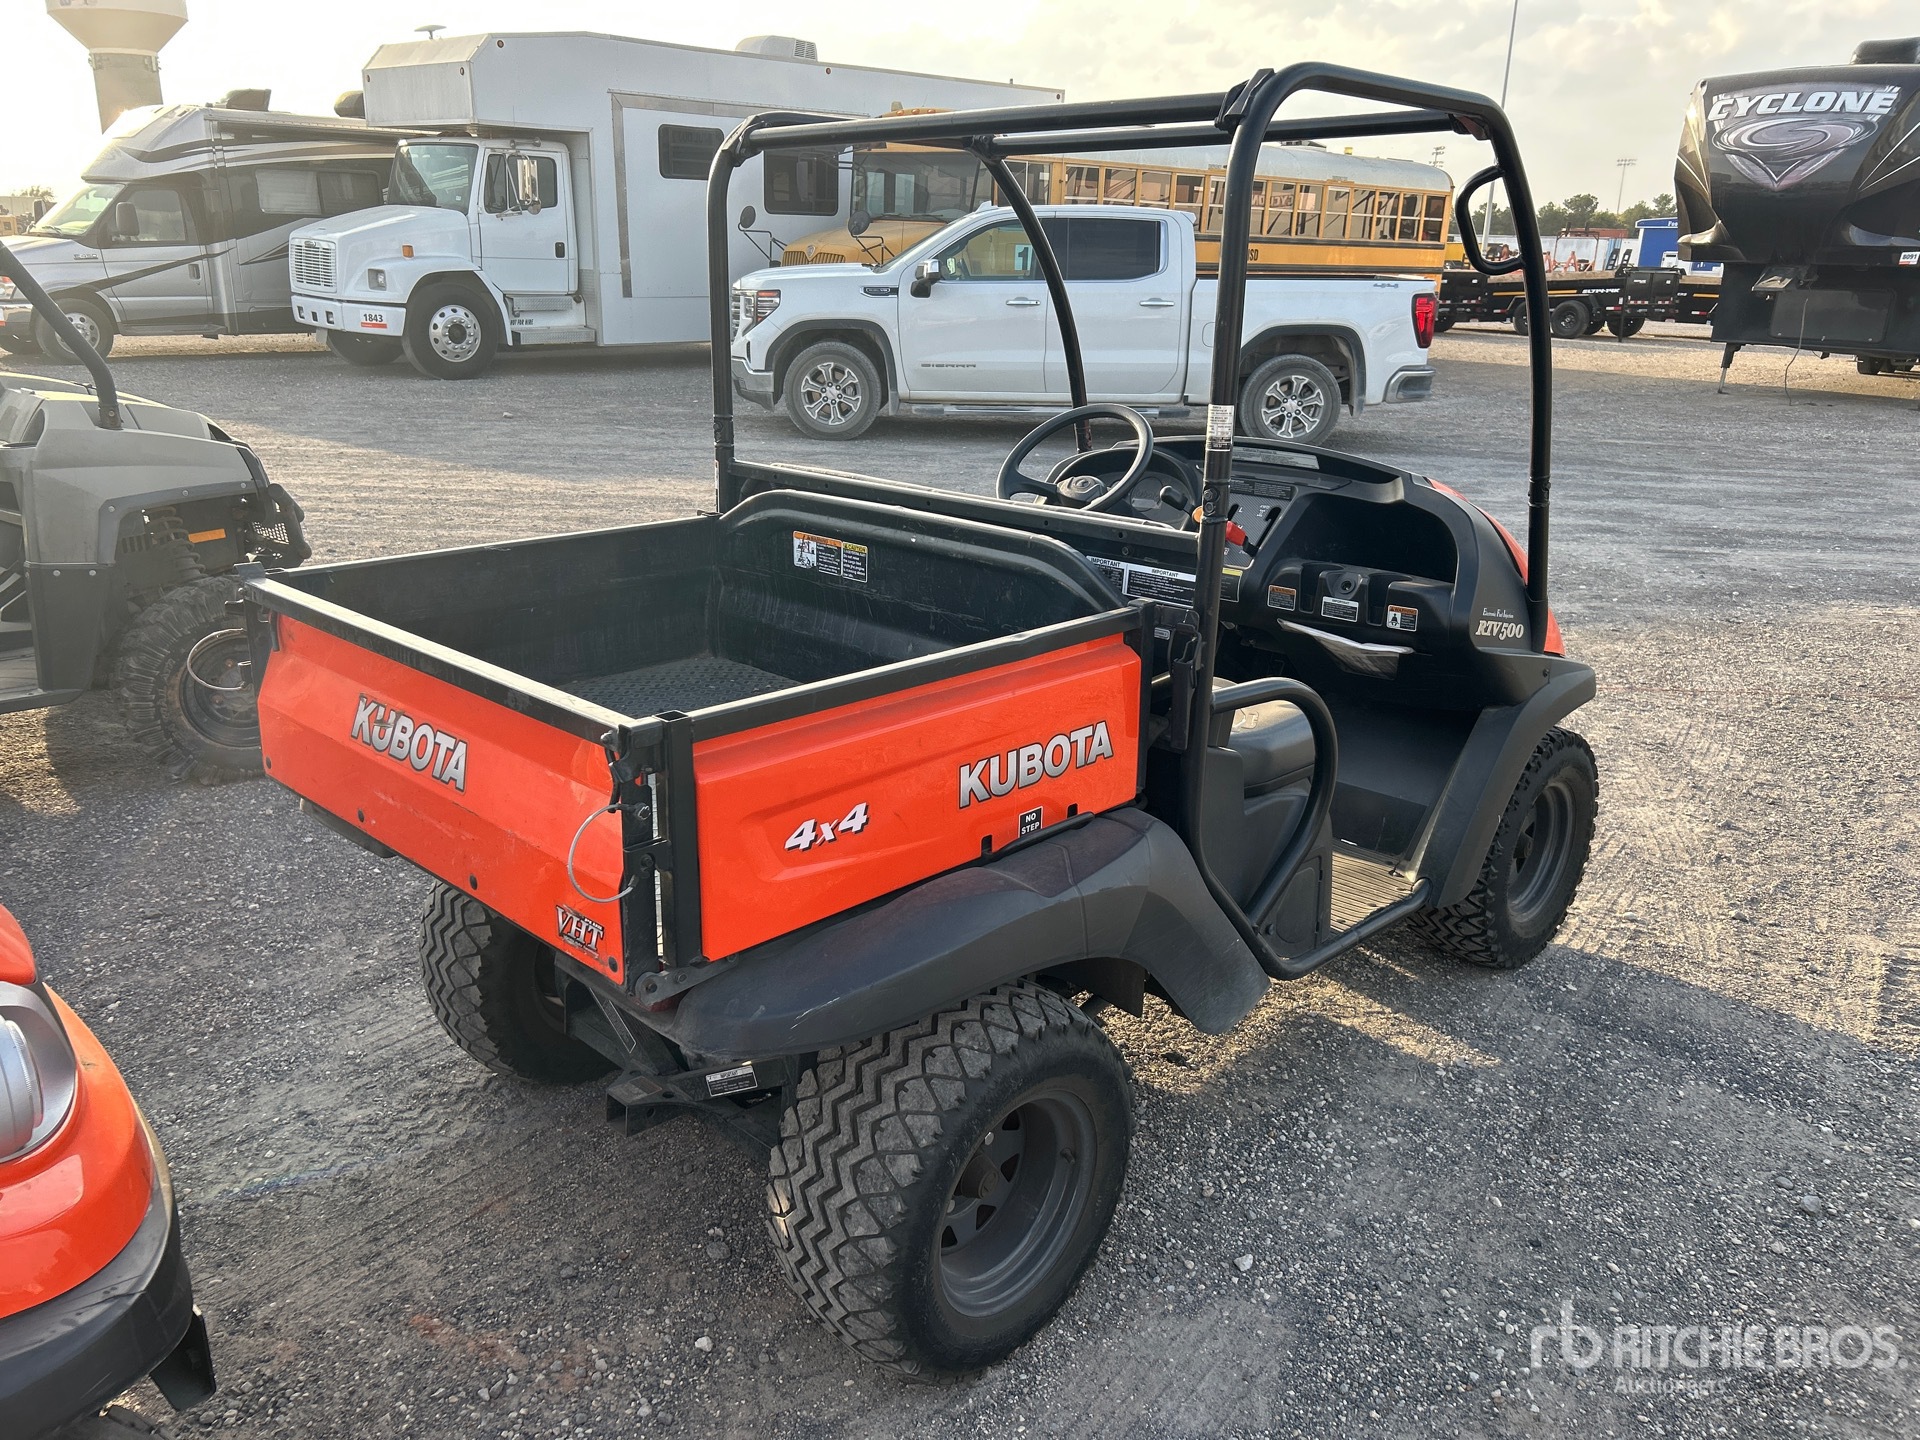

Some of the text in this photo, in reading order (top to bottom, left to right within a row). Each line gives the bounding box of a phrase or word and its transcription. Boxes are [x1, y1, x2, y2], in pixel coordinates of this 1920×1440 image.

[1708, 91, 1899, 121] CYCLONE
[363, 313, 384, 323] 1843
[1090, 558, 1121, 568] IMPORTANT
[1151, 568, 1179, 578] IMPORTANT
[1475, 620, 1524, 640] RTV500
[350, 693, 468, 793] KUBOTA
[958, 720, 1114, 809] KUBOTA
[784, 802, 870, 851] 4x4
[1025, 812, 1037, 823] NO
[1021, 821, 1040, 835] STEP
[556, 905, 605, 952] VHT
